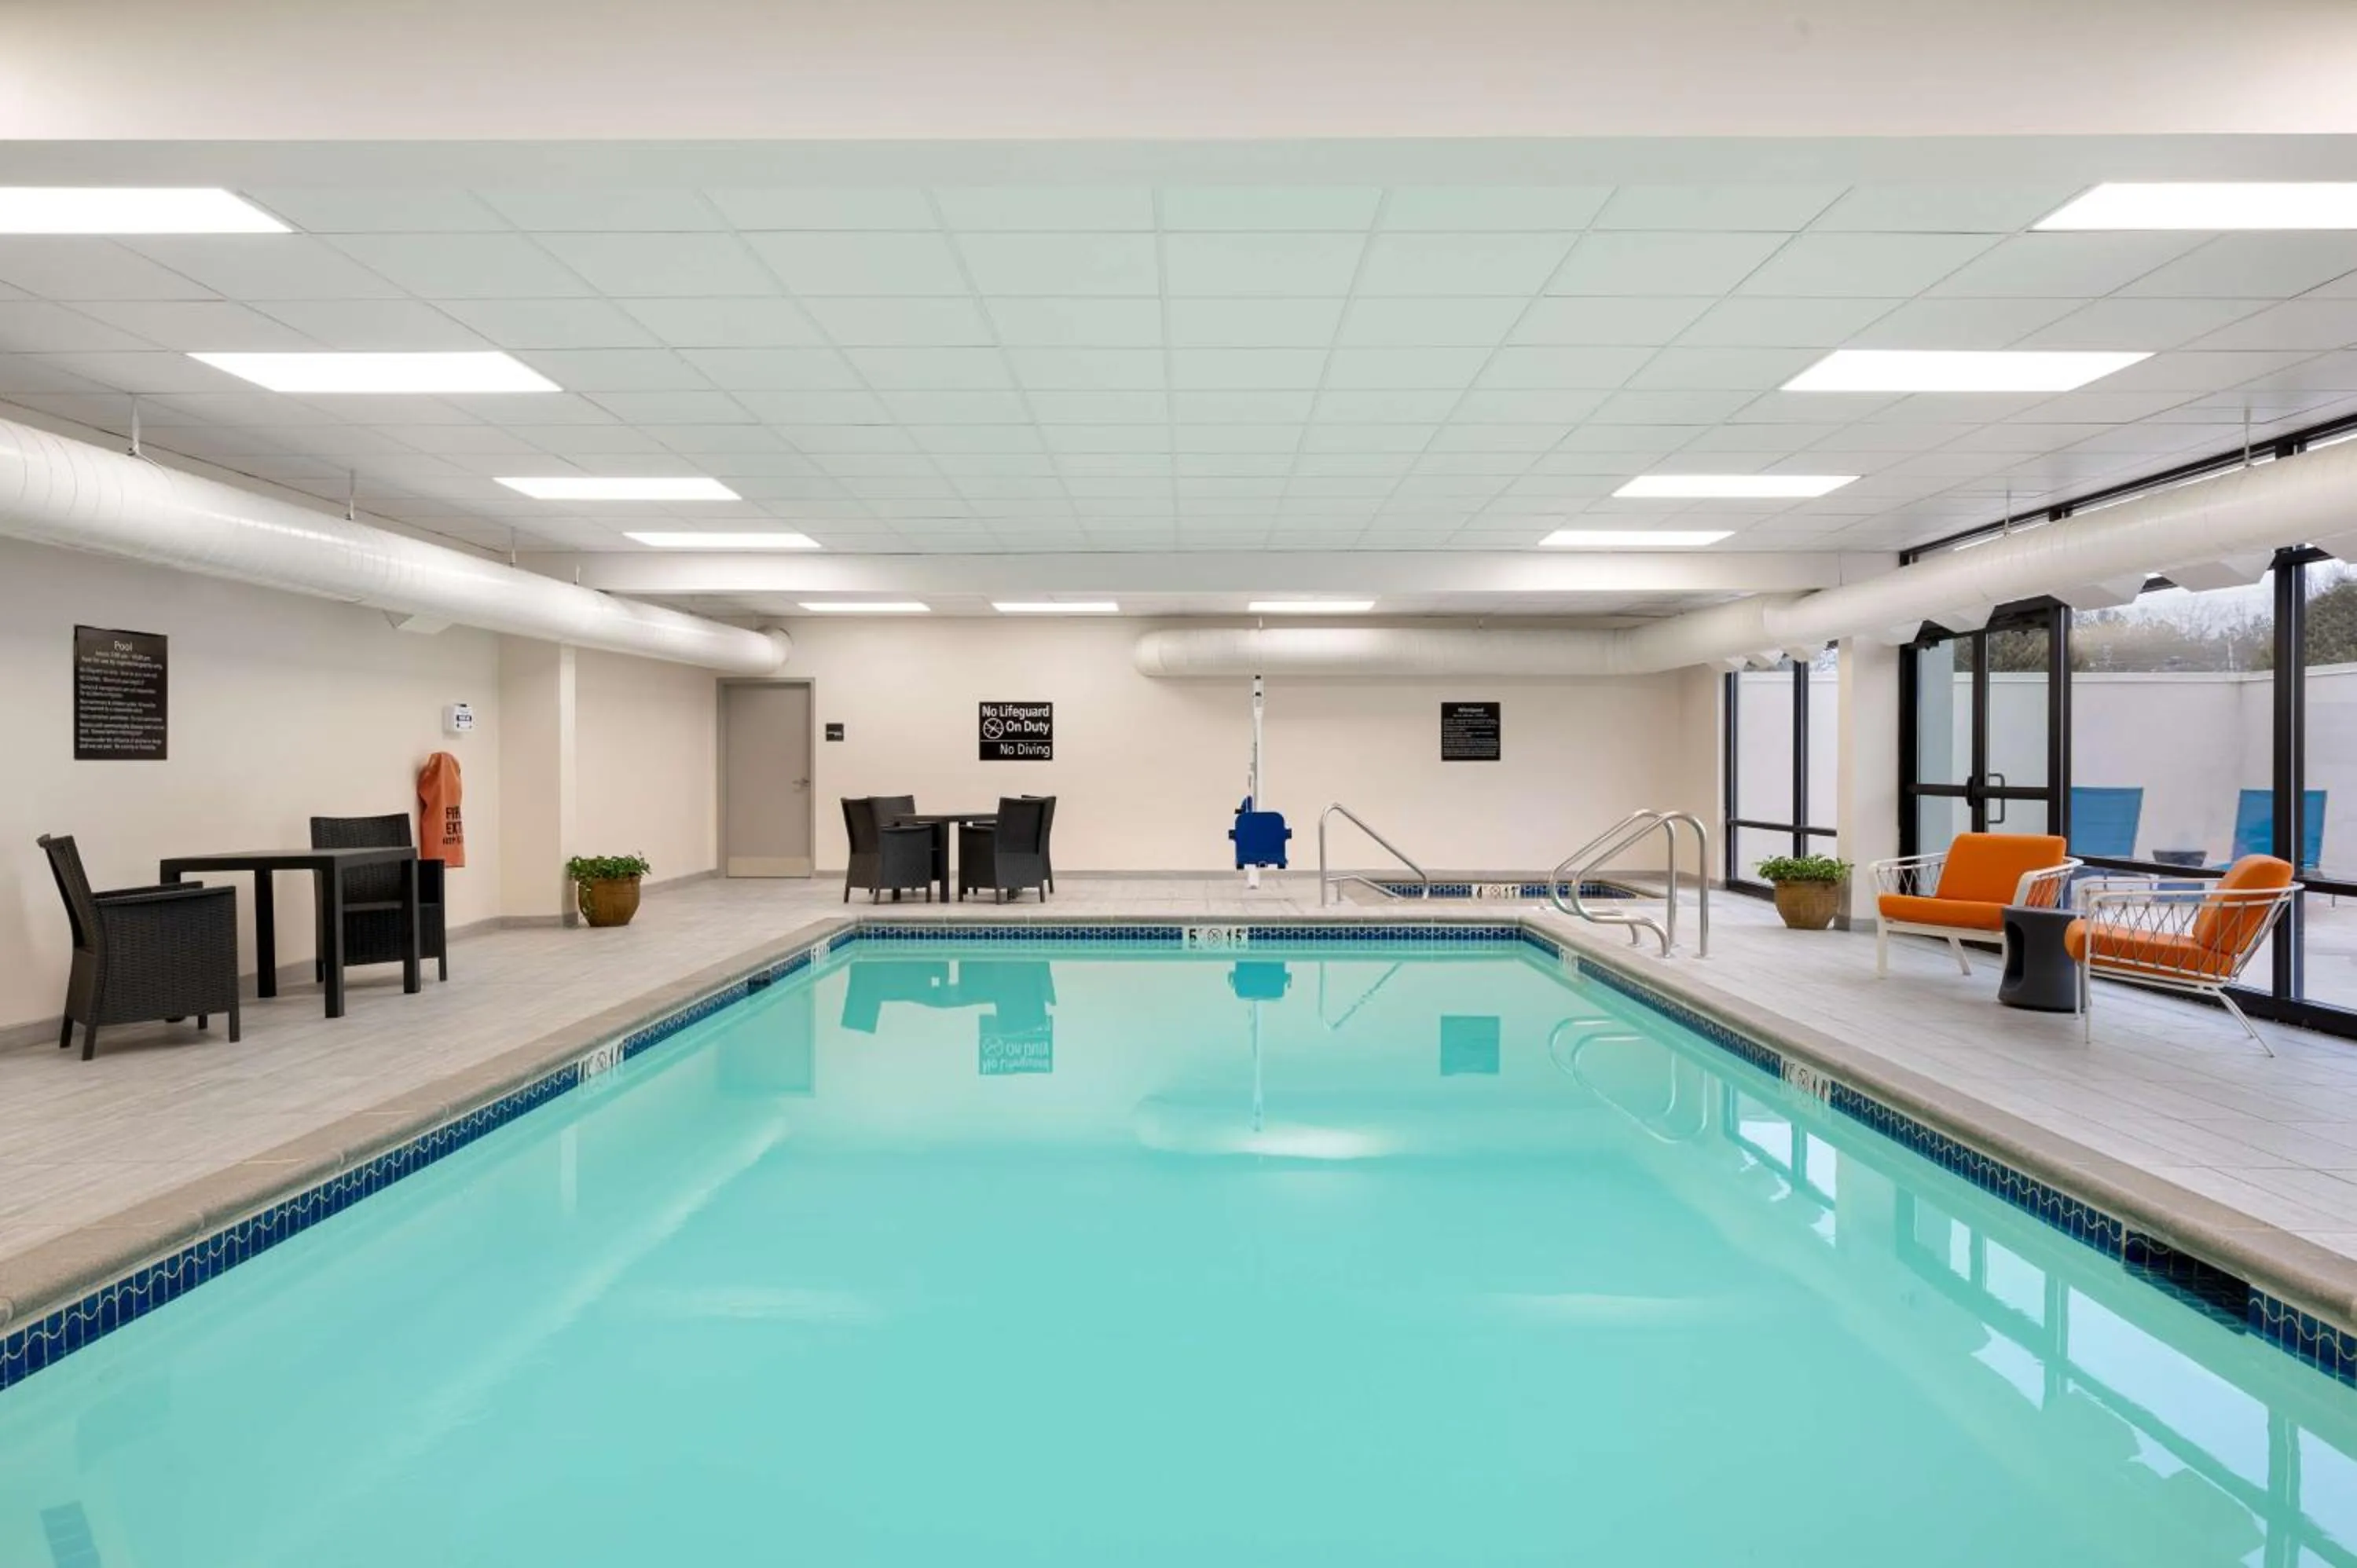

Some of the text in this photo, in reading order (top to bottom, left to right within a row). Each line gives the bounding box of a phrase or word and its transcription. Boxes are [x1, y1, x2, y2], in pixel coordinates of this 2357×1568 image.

[114, 640, 133, 651] Pool
[981, 705, 1050, 720] No Lifeguard
[1006, 720, 1050, 735] On Duty
[999, 743, 1050, 758] No Diving
[445, 805, 461, 820] FIR
[445, 821, 462, 835] EXT
